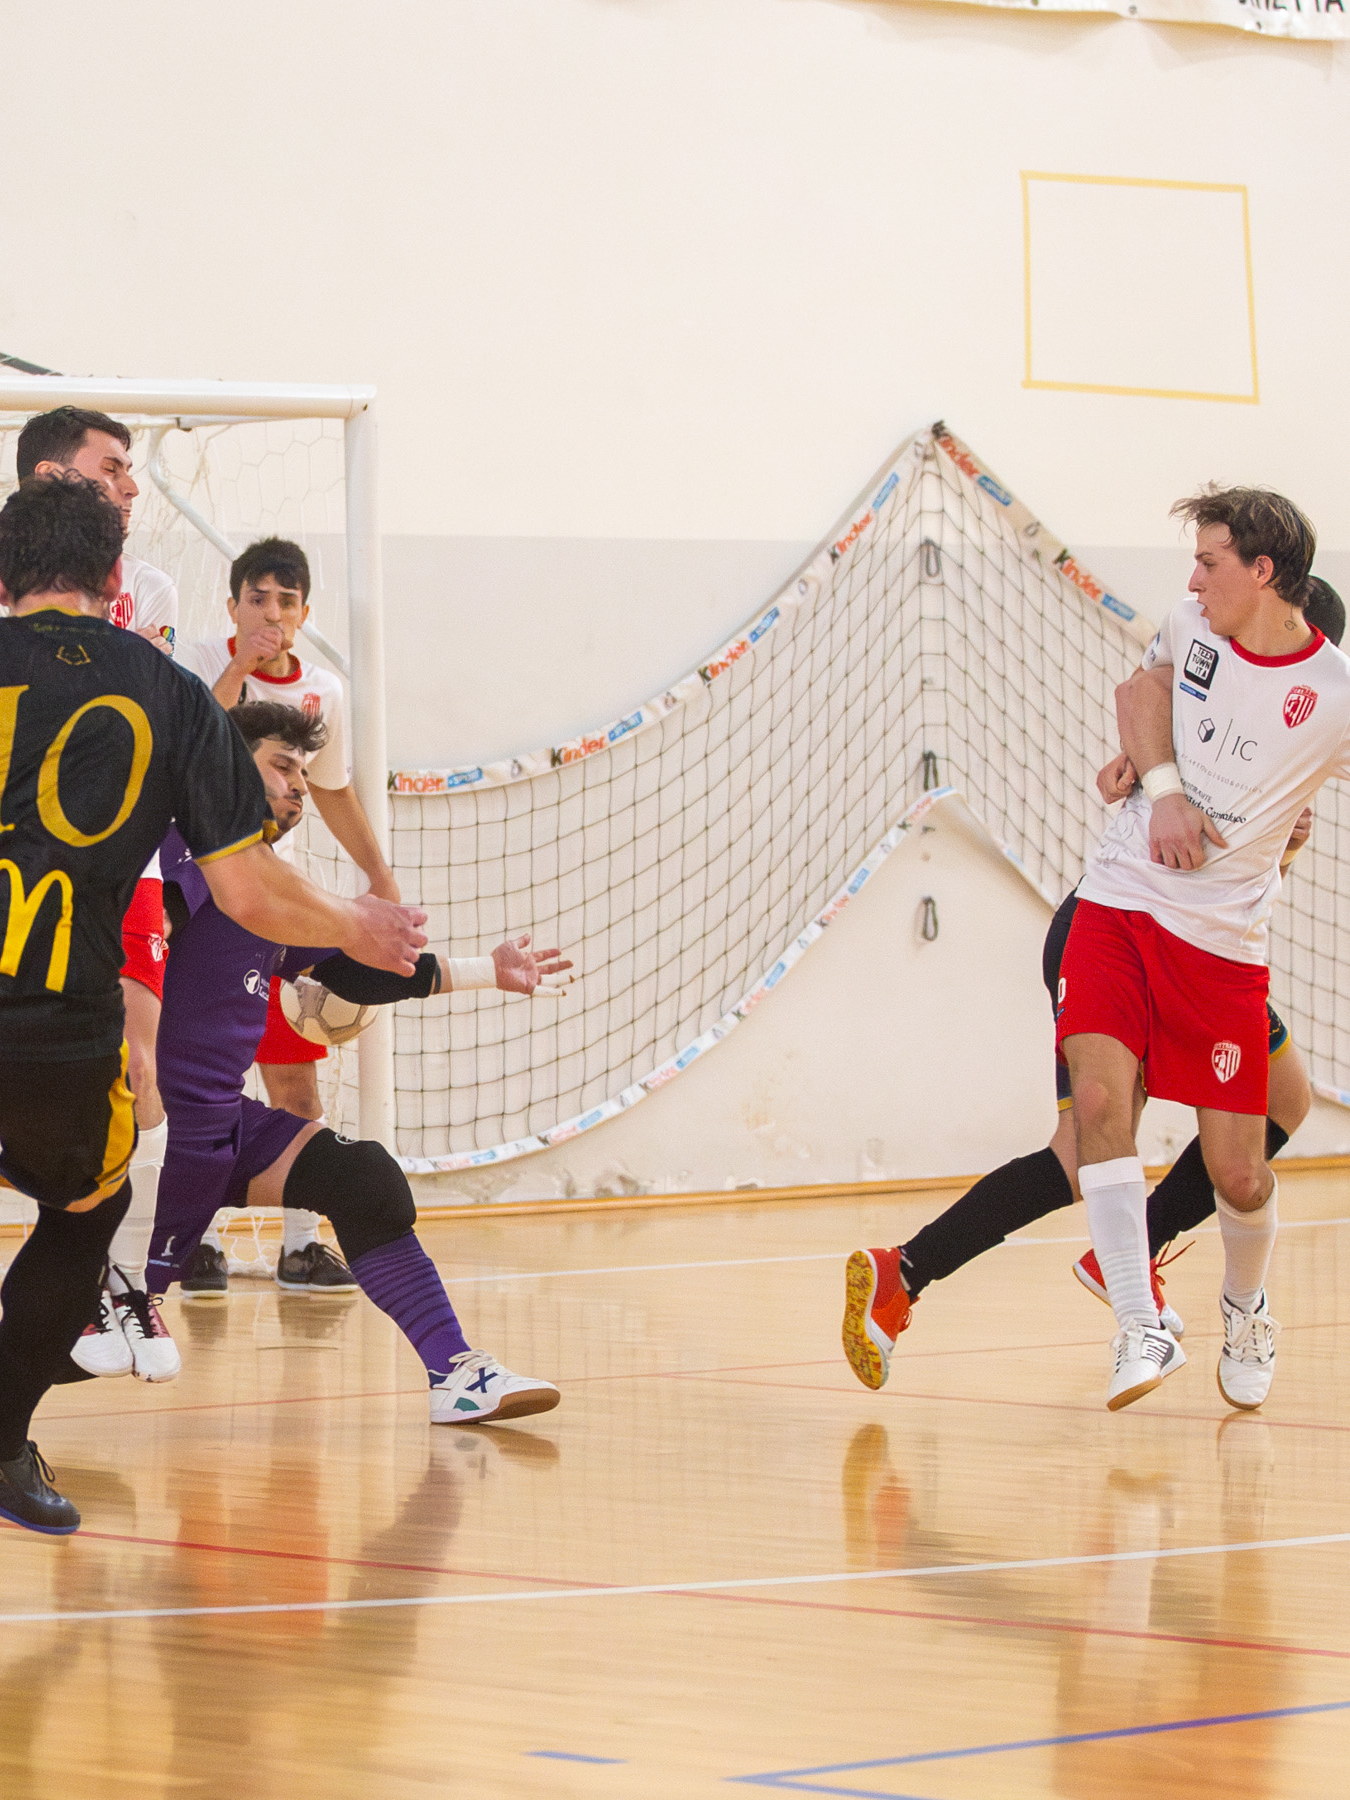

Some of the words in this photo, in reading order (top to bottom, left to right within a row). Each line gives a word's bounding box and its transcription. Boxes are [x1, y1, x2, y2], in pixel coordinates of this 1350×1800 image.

[1192, 653, 1211, 669] TOWN
[1197, 646, 1213, 661] TEEN
[1231, 735, 1257, 762] IC
